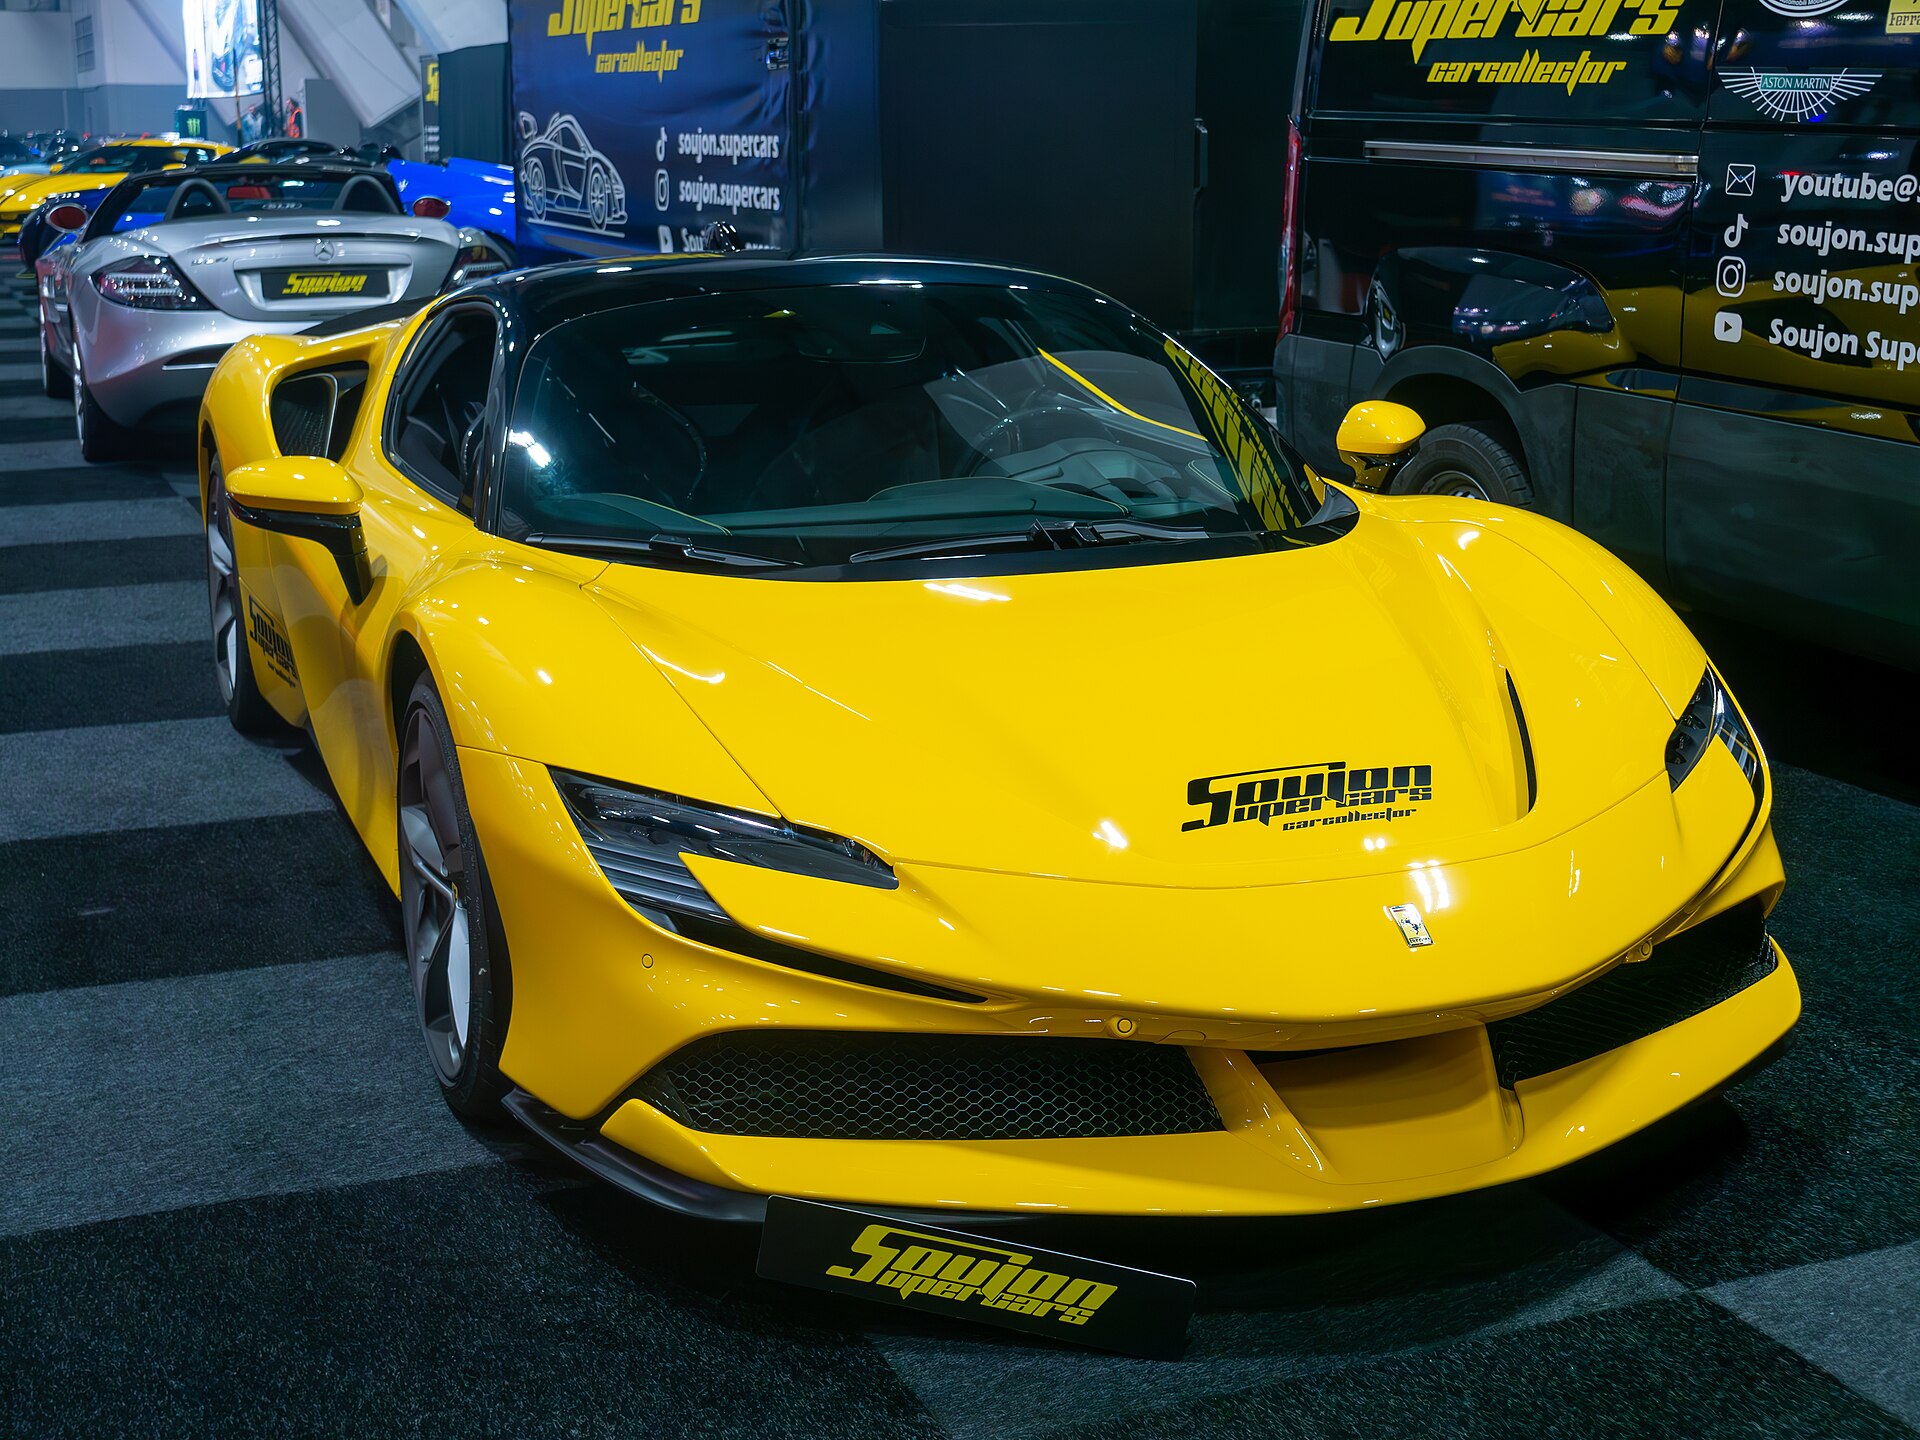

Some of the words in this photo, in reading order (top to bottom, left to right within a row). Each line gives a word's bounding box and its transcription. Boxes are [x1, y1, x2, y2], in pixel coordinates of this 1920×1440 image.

[595, 40, 685, 83] carcollector
[1427, 49, 1627, 96] carcollector
[1762, 77, 1794, 89] ASTON
[1794, 77, 1831, 89] MARTIN
[678, 127, 780, 165] soujon.supercars
[679, 175, 780, 215] soujon.supercars
[1773, 269, 1920, 314] soujon.sup
[1769, 318, 1858, 359] Soujon
[1865, 331, 1920, 371] Sup
[1181, 761, 1432, 832] Soujon
[1282, 807, 1417, 831] carcollector
[826, 1224, 1118, 1310] Soujon
